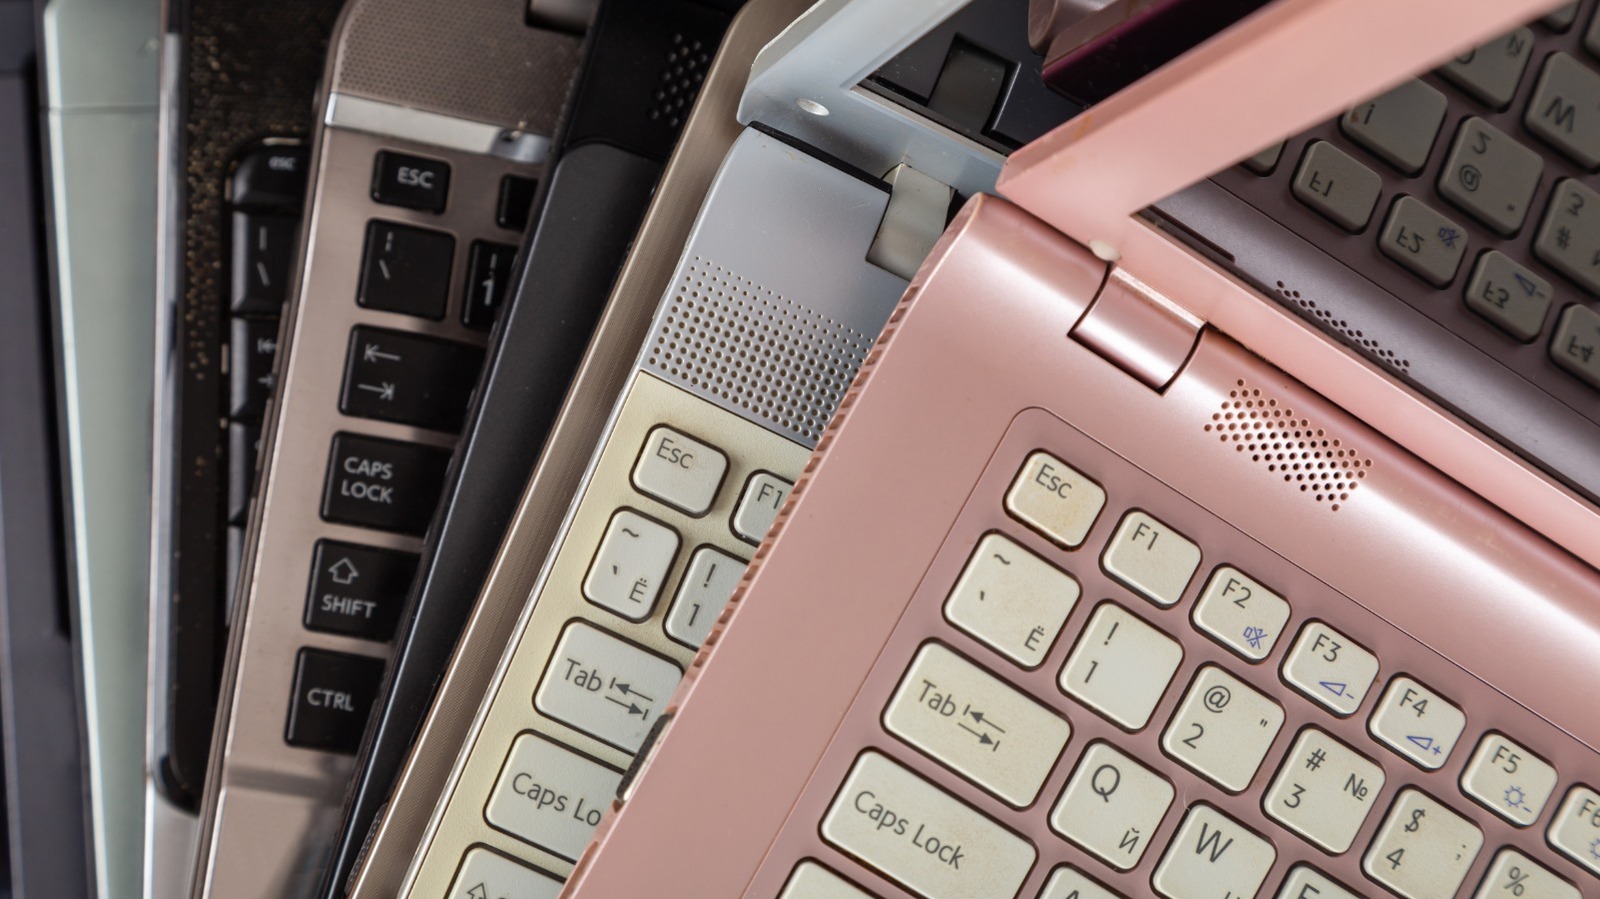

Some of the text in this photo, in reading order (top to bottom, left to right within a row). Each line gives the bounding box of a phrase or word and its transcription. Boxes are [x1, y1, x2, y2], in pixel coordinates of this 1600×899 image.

[397, 166, 435, 189] ESC
[482, 278, 495, 306] 1
[656, 437, 694, 469] Esc
[344, 457, 393, 480] CAPS
[1035, 463, 1073, 499] Esc
[341, 479, 393, 504] LOCK
[757, 482, 783, 510] F1
[1132, 522, 1159, 551] F1
[320, 593, 377, 619] SHIFT
[1221, 577, 1252, 609] F2
[688, 603, 700, 627] 1
[1311, 633, 1342, 663] F3
[563, 657, 602, 692] Tab
[1084, 660, 1099, 684] 1
[307, 688, 354, 712] CTRL
[918, 679, 957, 717] Tab
[1203, 685, 1232, 714] @
[1400, 688, 1429, 718] F4
[1182, 722, 1205, 750] 2
[1305, 748, 1328, 772] #
[1491, 745, 1522, 774] F5
[1091, 764, 1121, 803] Q
[1283, 783, 1307, 809] 3
[512, 772, 602, 827] Caps Lo
[854, 790, 965, 870] Caps Lock
[1404, 808, 1426, 833] $
[1195, 822, 1234, 863] W
[1386, 848, 1406, 870] 4
[1504, 866, 1529, 897] %
